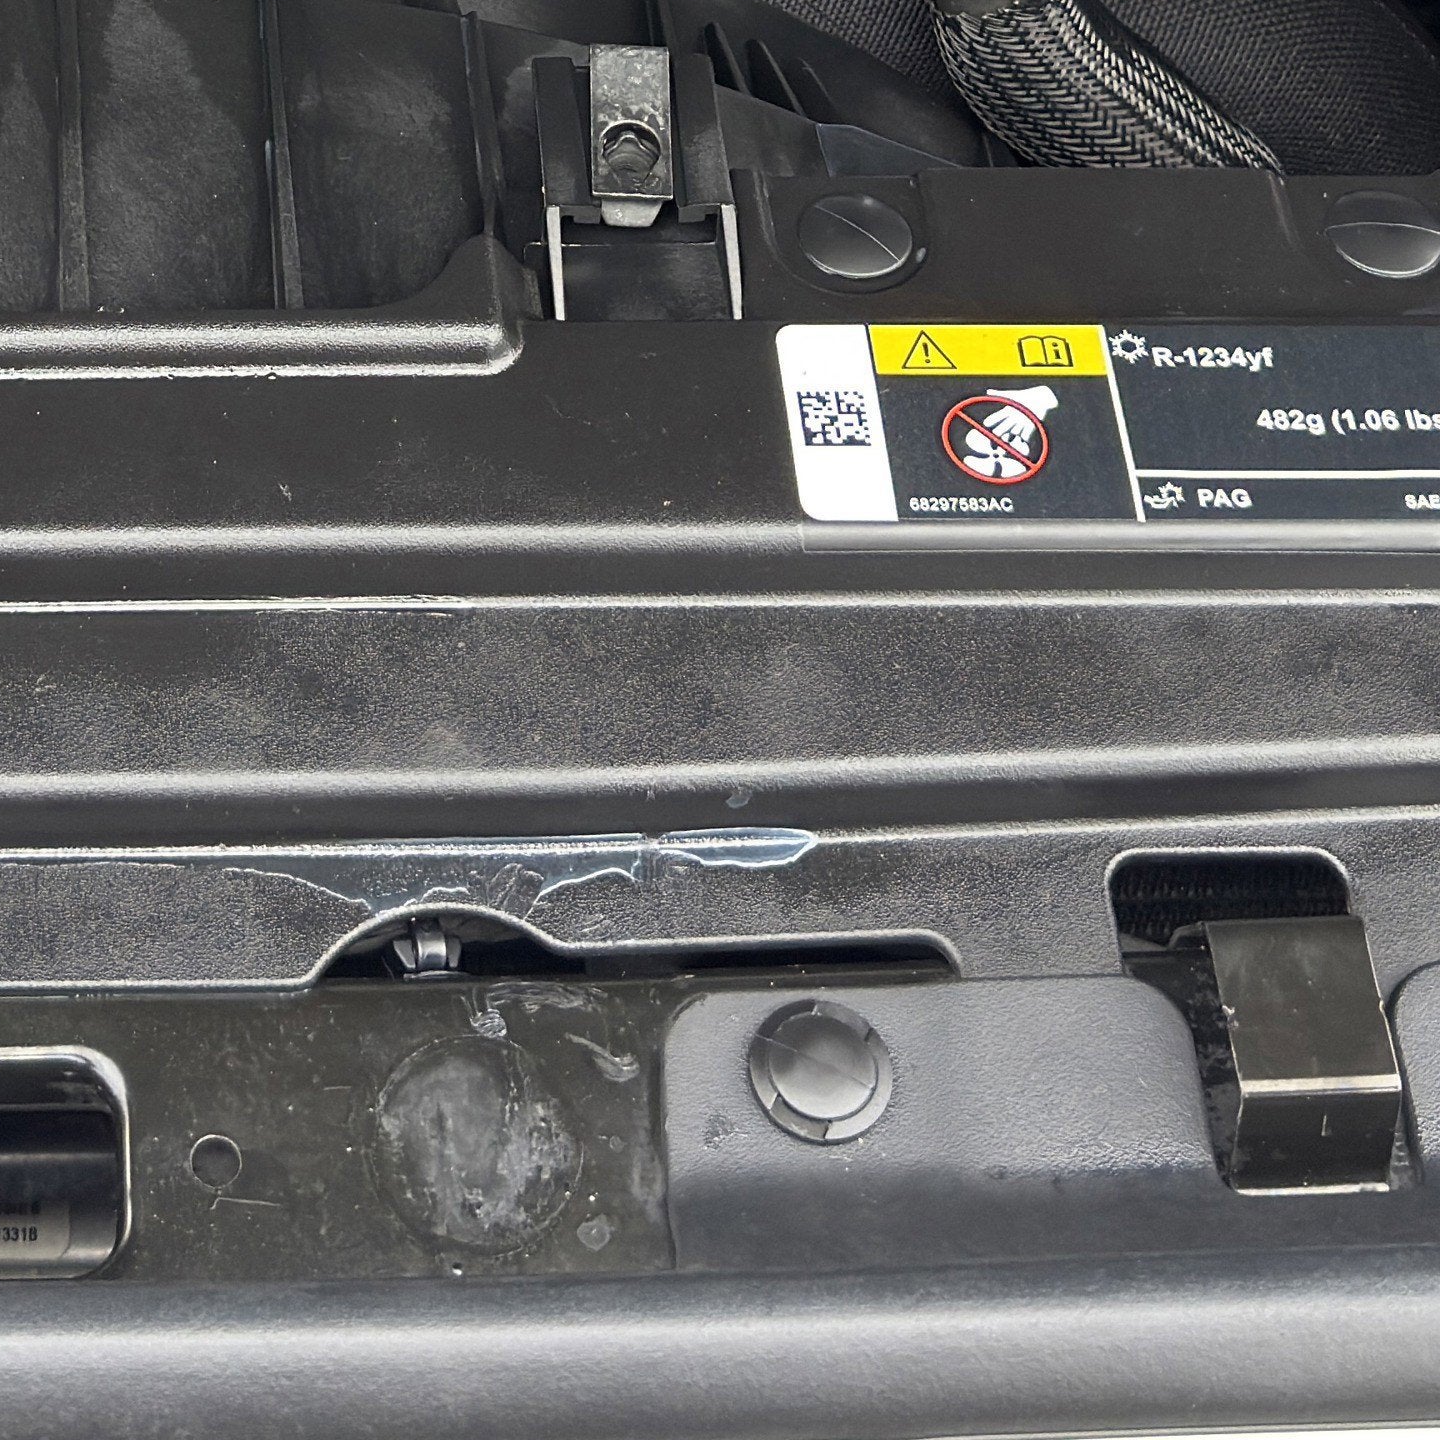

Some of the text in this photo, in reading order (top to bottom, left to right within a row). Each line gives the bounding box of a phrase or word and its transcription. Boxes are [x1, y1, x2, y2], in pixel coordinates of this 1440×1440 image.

[1151, 347, 1274, 372] R-1234yf
[1256, 409, 1326, 435] 482g
[1331, 410, 1400, 435] (1.06
[909, 496, 1014, 512] 68297583AC
[1197, 488, 1253, 508] PAG
